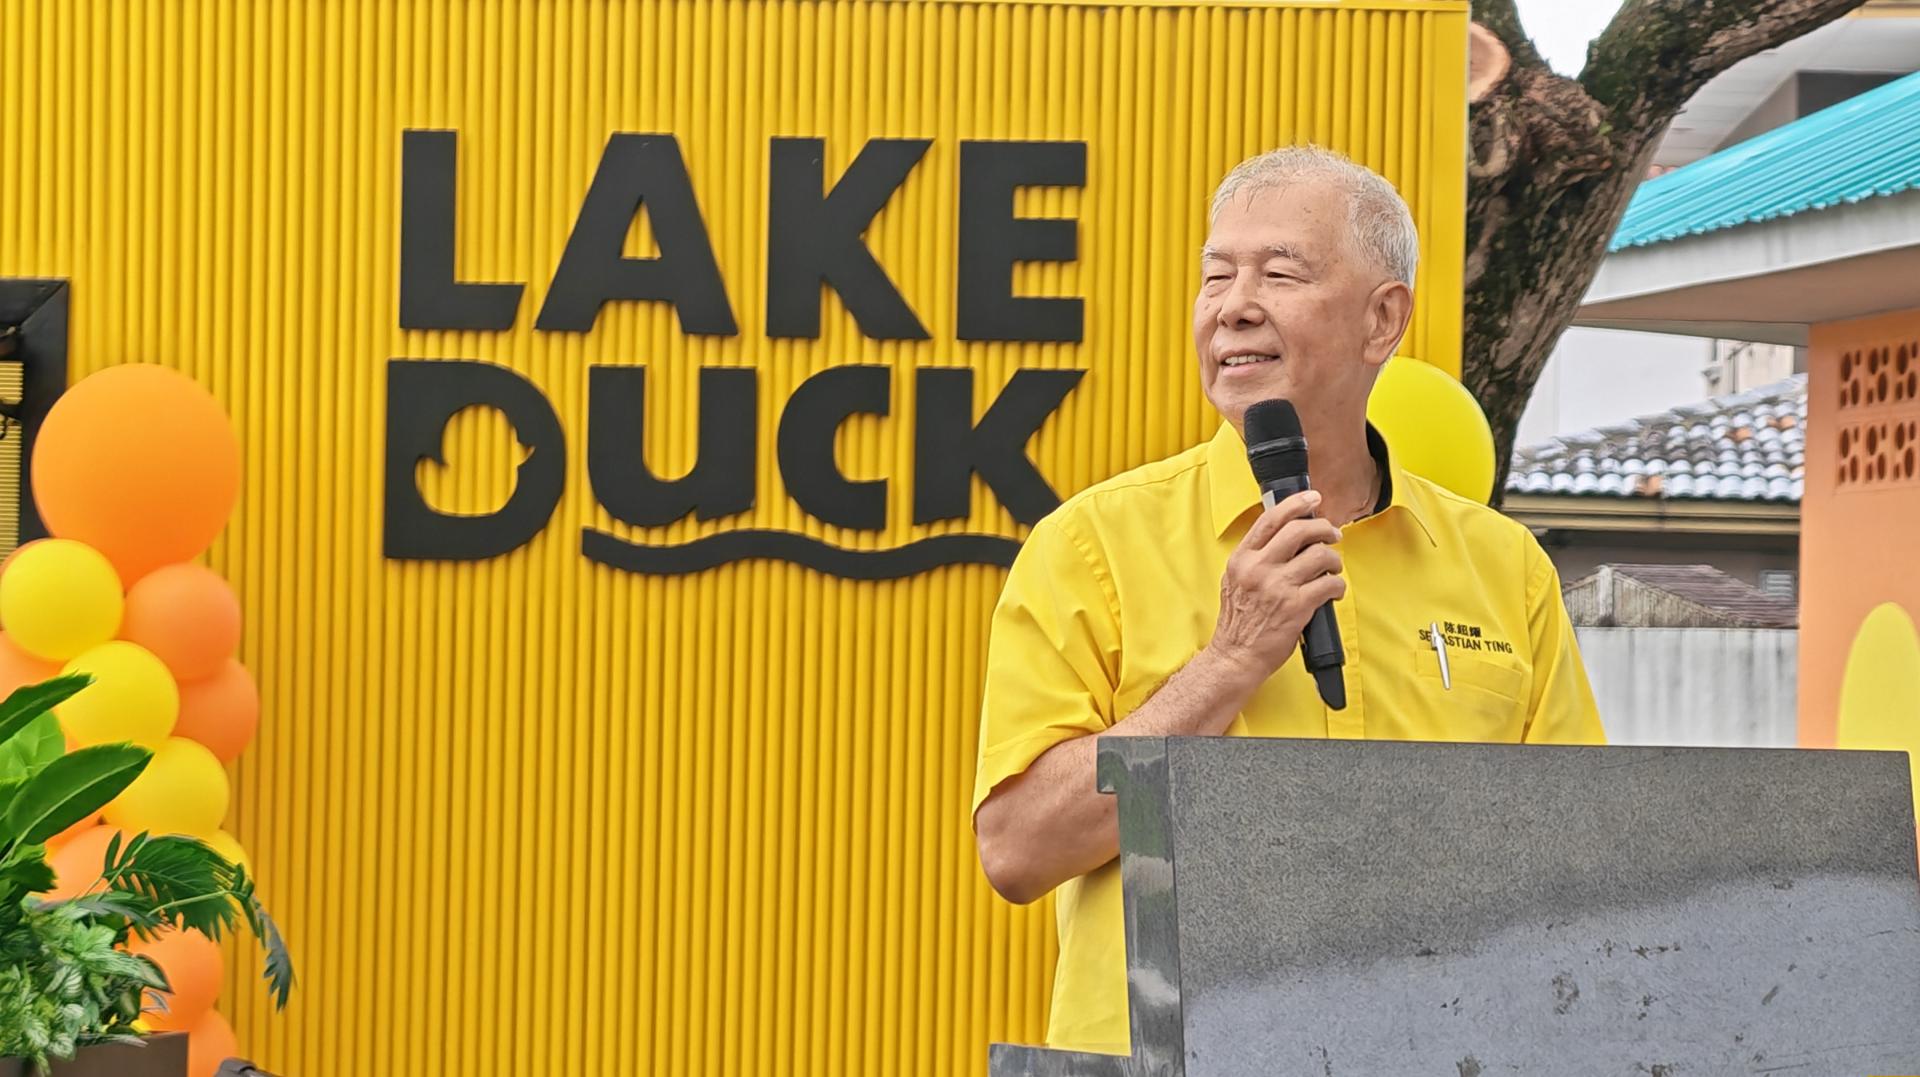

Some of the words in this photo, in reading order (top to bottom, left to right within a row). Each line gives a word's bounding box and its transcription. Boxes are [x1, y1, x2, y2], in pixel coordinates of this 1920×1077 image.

[399, 129, 1088, 342] LAKE
[1418, 629, 1482, 651] SEASTIAN
[1484, 640, 1513, 654] TING
